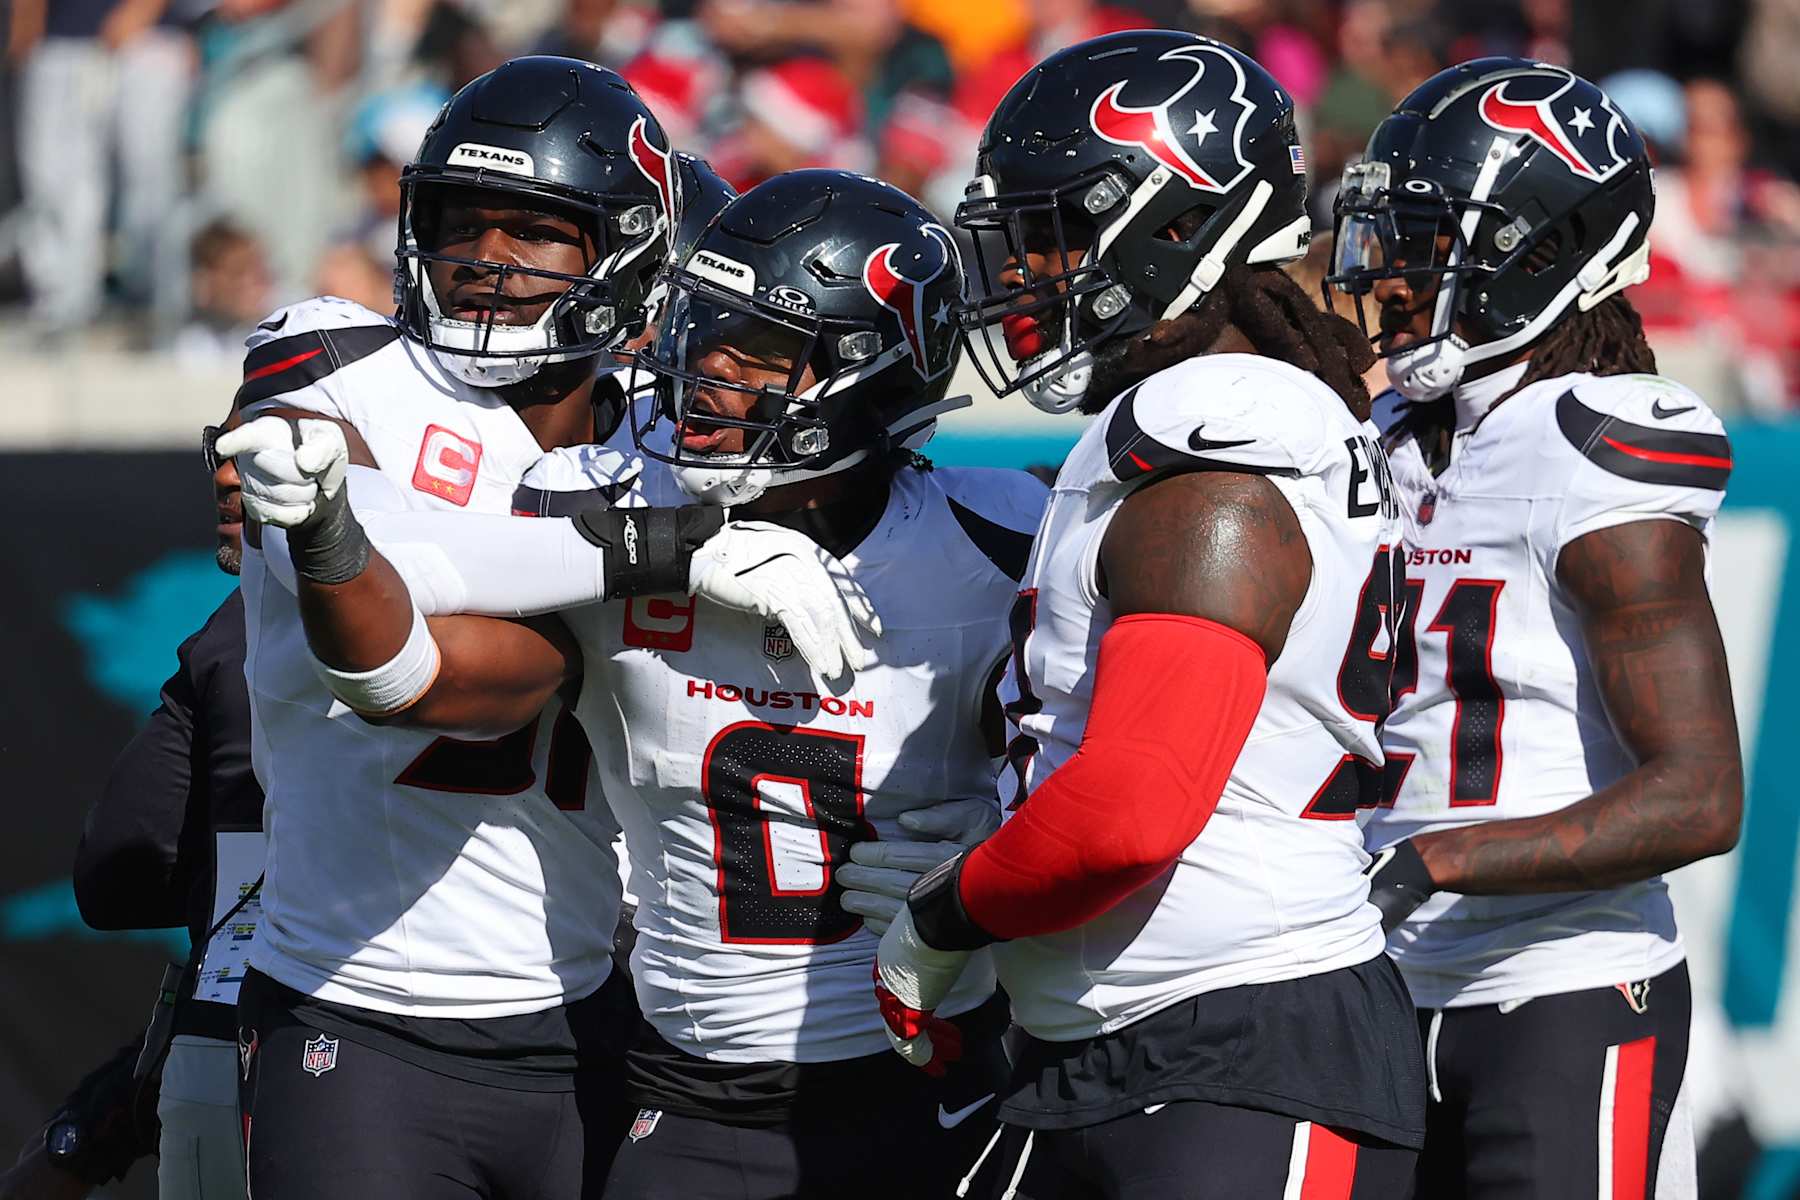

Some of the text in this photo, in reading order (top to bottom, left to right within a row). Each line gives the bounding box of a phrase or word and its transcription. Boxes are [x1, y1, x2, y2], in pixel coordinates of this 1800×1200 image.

[459, 147, 525, 165] TEXANS
[697, 254, 745, 278] TEXANS
[768, 295, 815, 315] OAKLEY
[423, 431, 476, 487] C
[766, 639, 792, 656] NFL
[687, 679, 875, 719] HOUSTON
[701, 719, 878, 945] 0
[308, 1052, 332, 1069] NFL
